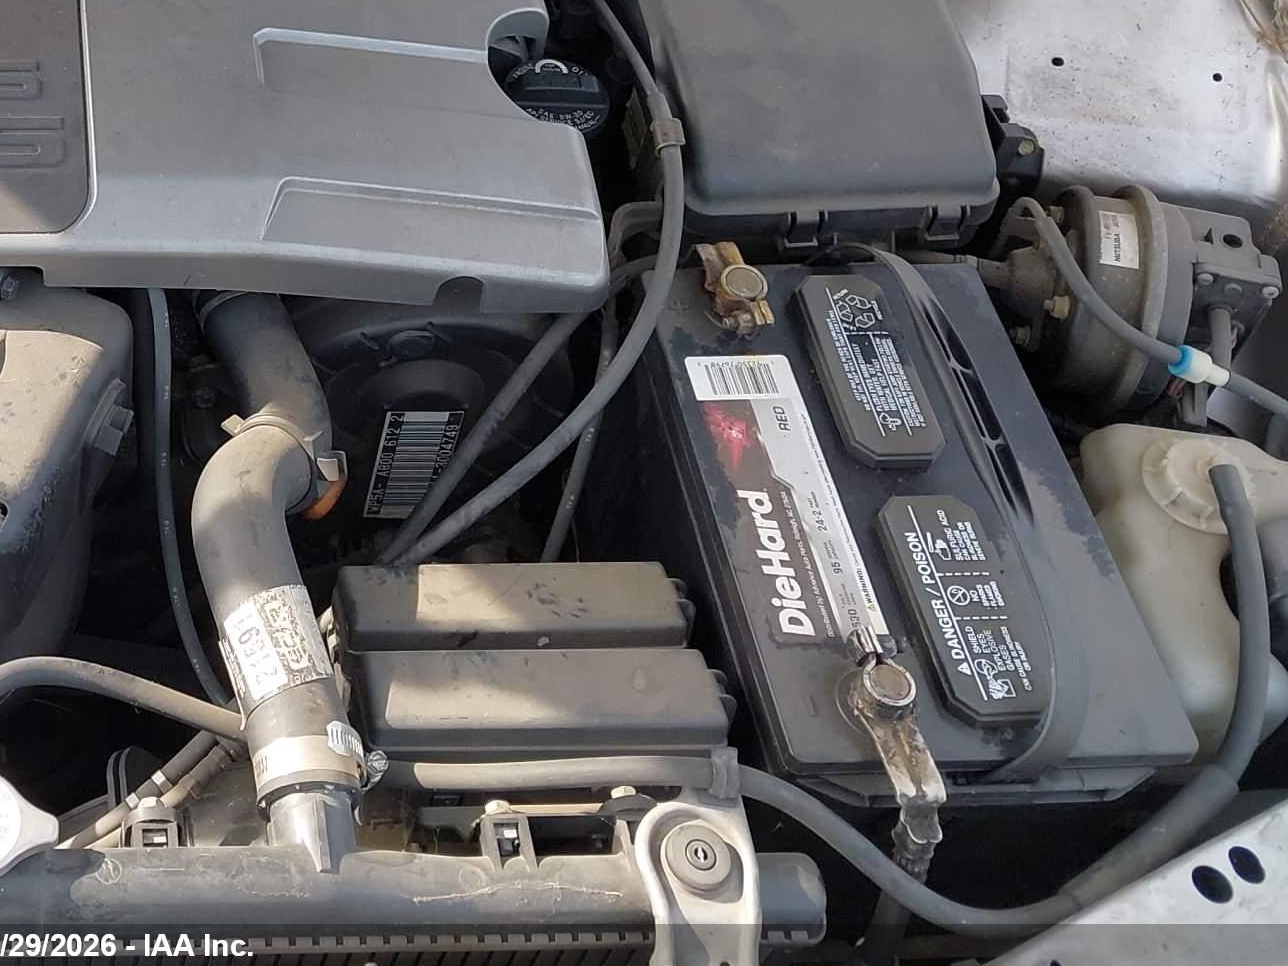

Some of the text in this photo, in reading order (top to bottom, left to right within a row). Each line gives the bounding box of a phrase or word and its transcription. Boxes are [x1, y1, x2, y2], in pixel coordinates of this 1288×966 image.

[390, 414, 405, 422] 2
[776, 405, 792, 432] RED
[384, 427, 401, 447] 612
[811, 510, 827, 531] 24-2
[935, 509, 964, 560] SULFURIC ACID
[952, 529, 971, 560] CAN CAUSE
[736, 489, 816, 636] DieHard
[830, 561, 843, 574] 95
[853, 567, 874, 603] WARNING:
[903, 531, 966, 659] DANGER / POISON
[968, 589, 980, 601] NO
[963, 625, 982, 653] SHIELD
[975, 633, 990, 653] EYES
[982, 629, 1006, 670] EXPLOSIVE
[997, 644, 1015, 670] GASES
[1012, 657, 1027, 677] CAUSE
